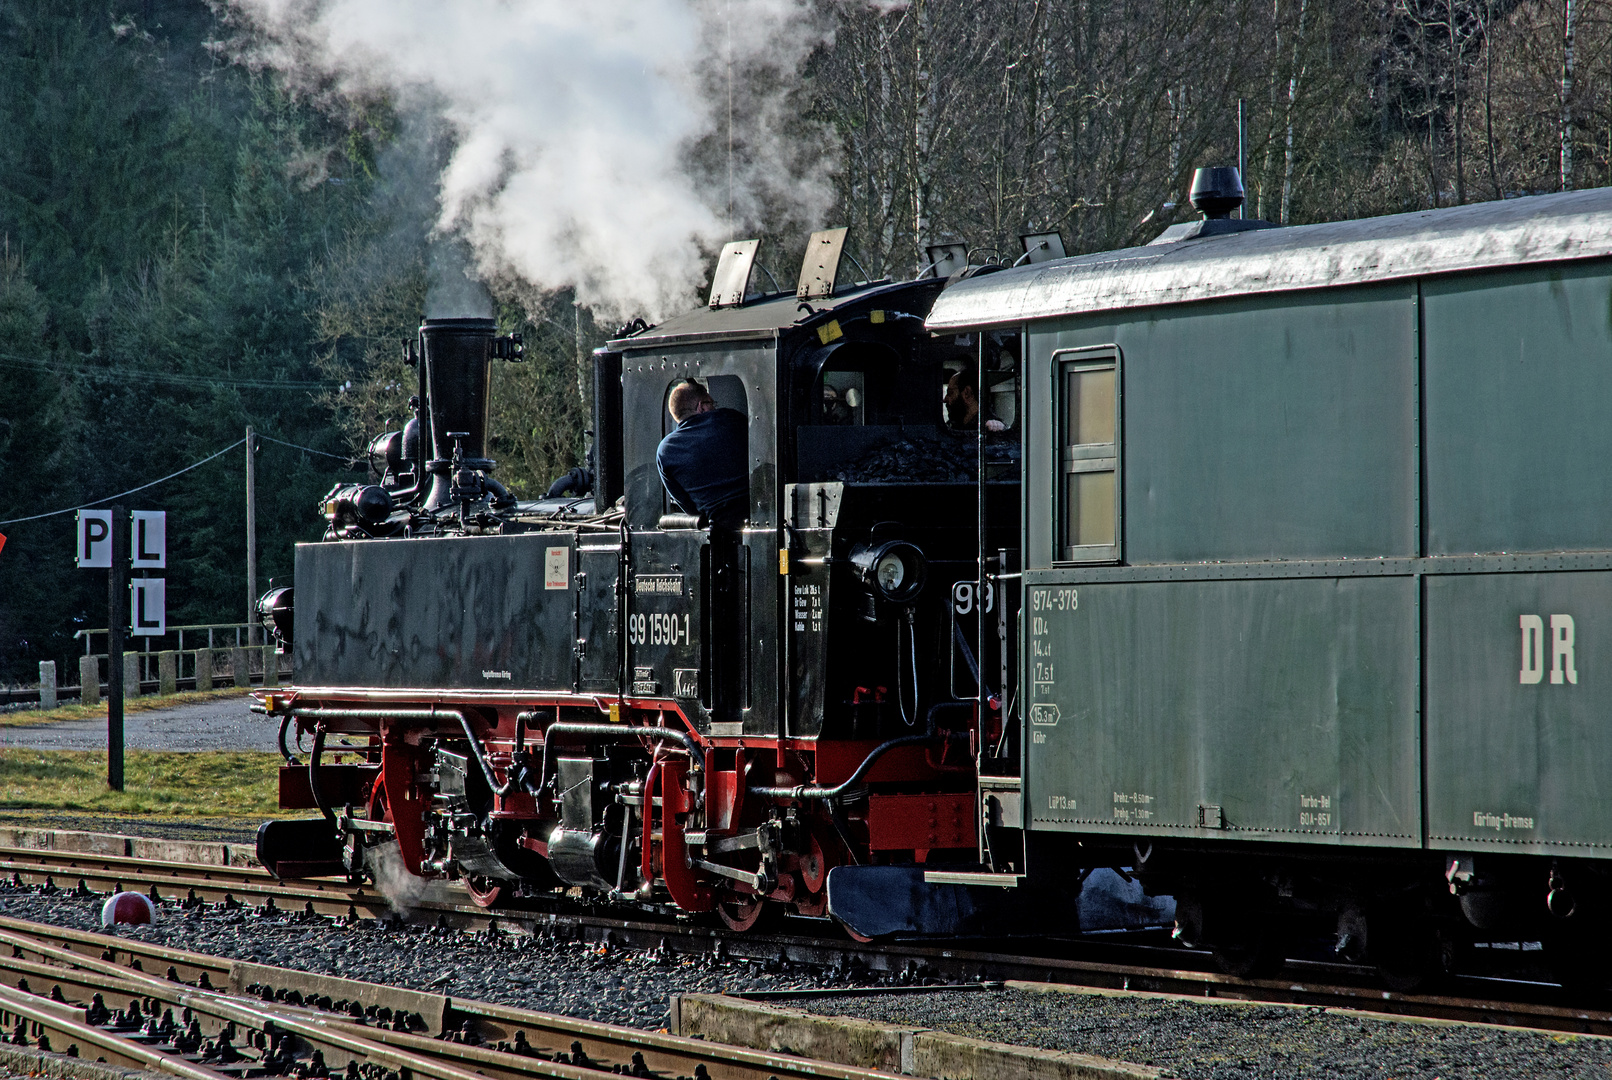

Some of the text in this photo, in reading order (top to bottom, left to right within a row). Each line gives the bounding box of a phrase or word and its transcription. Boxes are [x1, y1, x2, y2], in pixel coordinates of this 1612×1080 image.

[85, 518, 108, 559] P
[138, 519, 160, 560] L
[137, 586, 160, 628] L
[955, 583, 994, 615] 99
[1033, 589, 1078, 611] 974-378
[629, 613, 690, 645] 99 1590-1
[1519, 614, 1578, 684] DR
